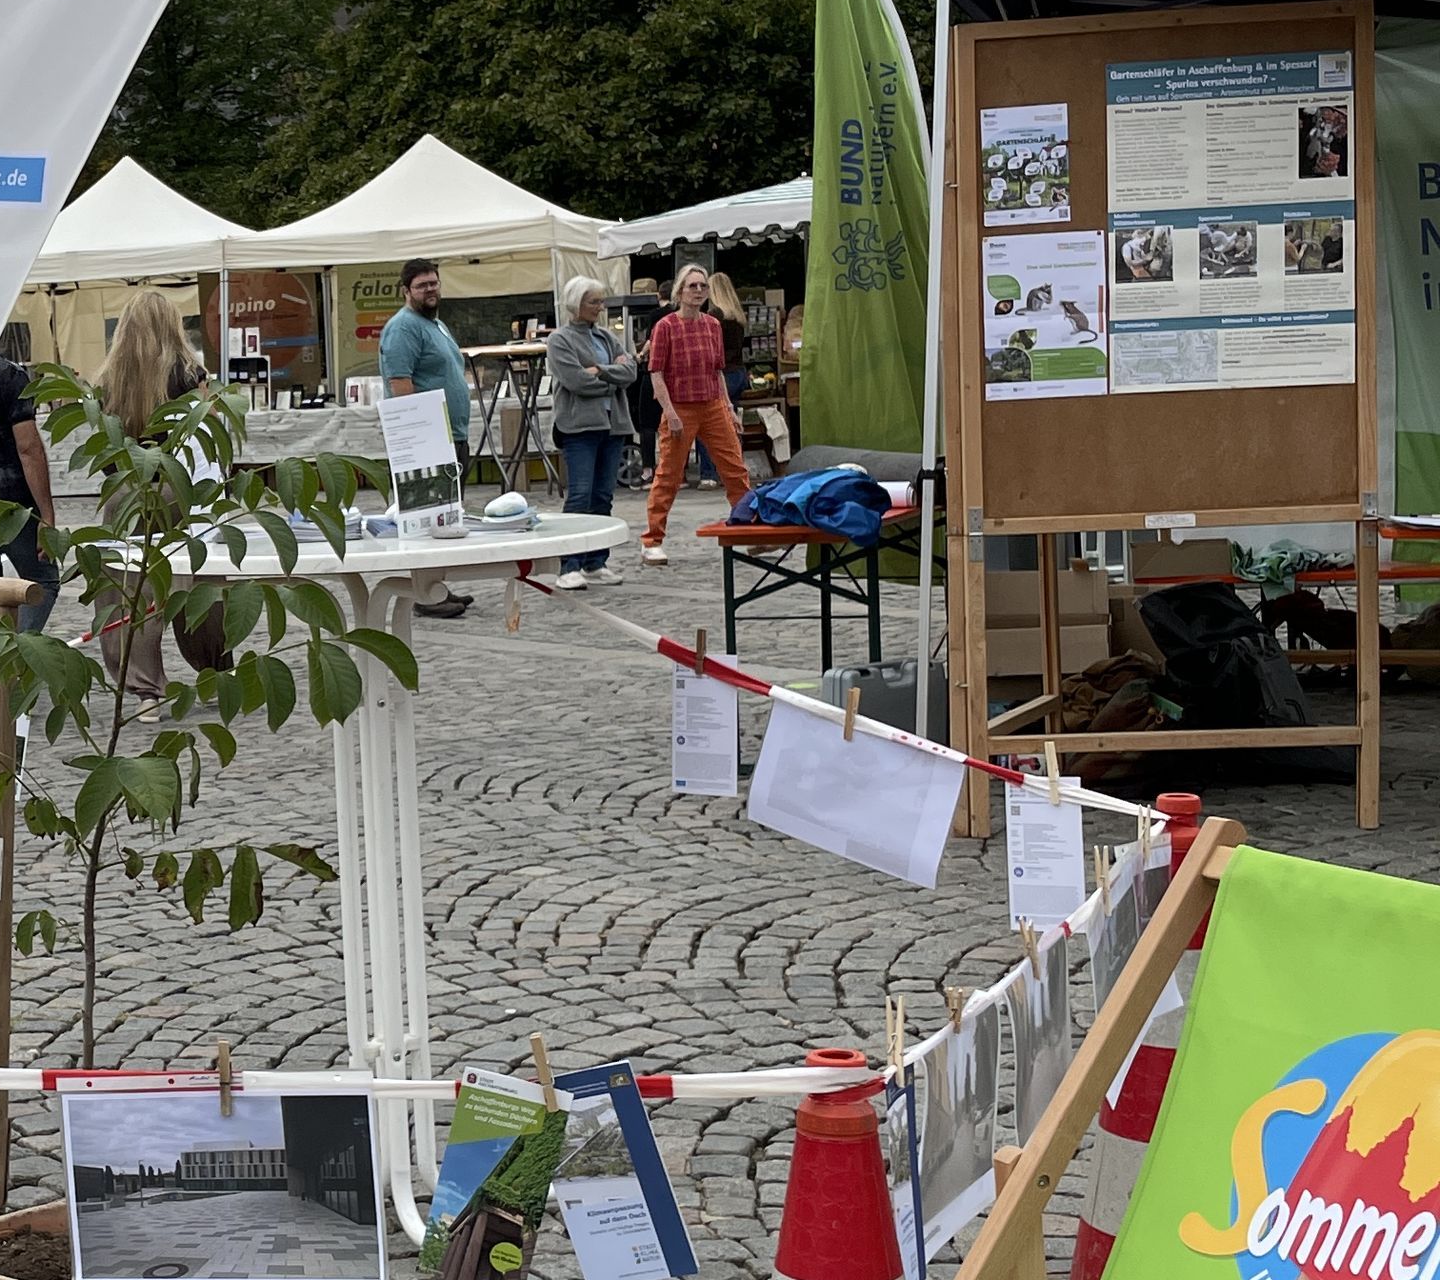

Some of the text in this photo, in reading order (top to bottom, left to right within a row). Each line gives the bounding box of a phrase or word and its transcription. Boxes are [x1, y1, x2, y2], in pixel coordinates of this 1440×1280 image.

[879, 61, 898, 96] e.V.
[1110, 68, 1174, 80] Gartenschläfer
[1177, 66, 1186, 75] in
[1188, 63, 1253, 76] Aschaffenburg
[1266, 61, 1277, 70] im
[1280, 60, 1318, 71] Spessart
[1166, 79, 1199, 90] Spurlos
[1201, 74, 1268, 88] verschwunden?
[840, 119, 864, 206] BUND
[352, 279, 402, 301] falaf
